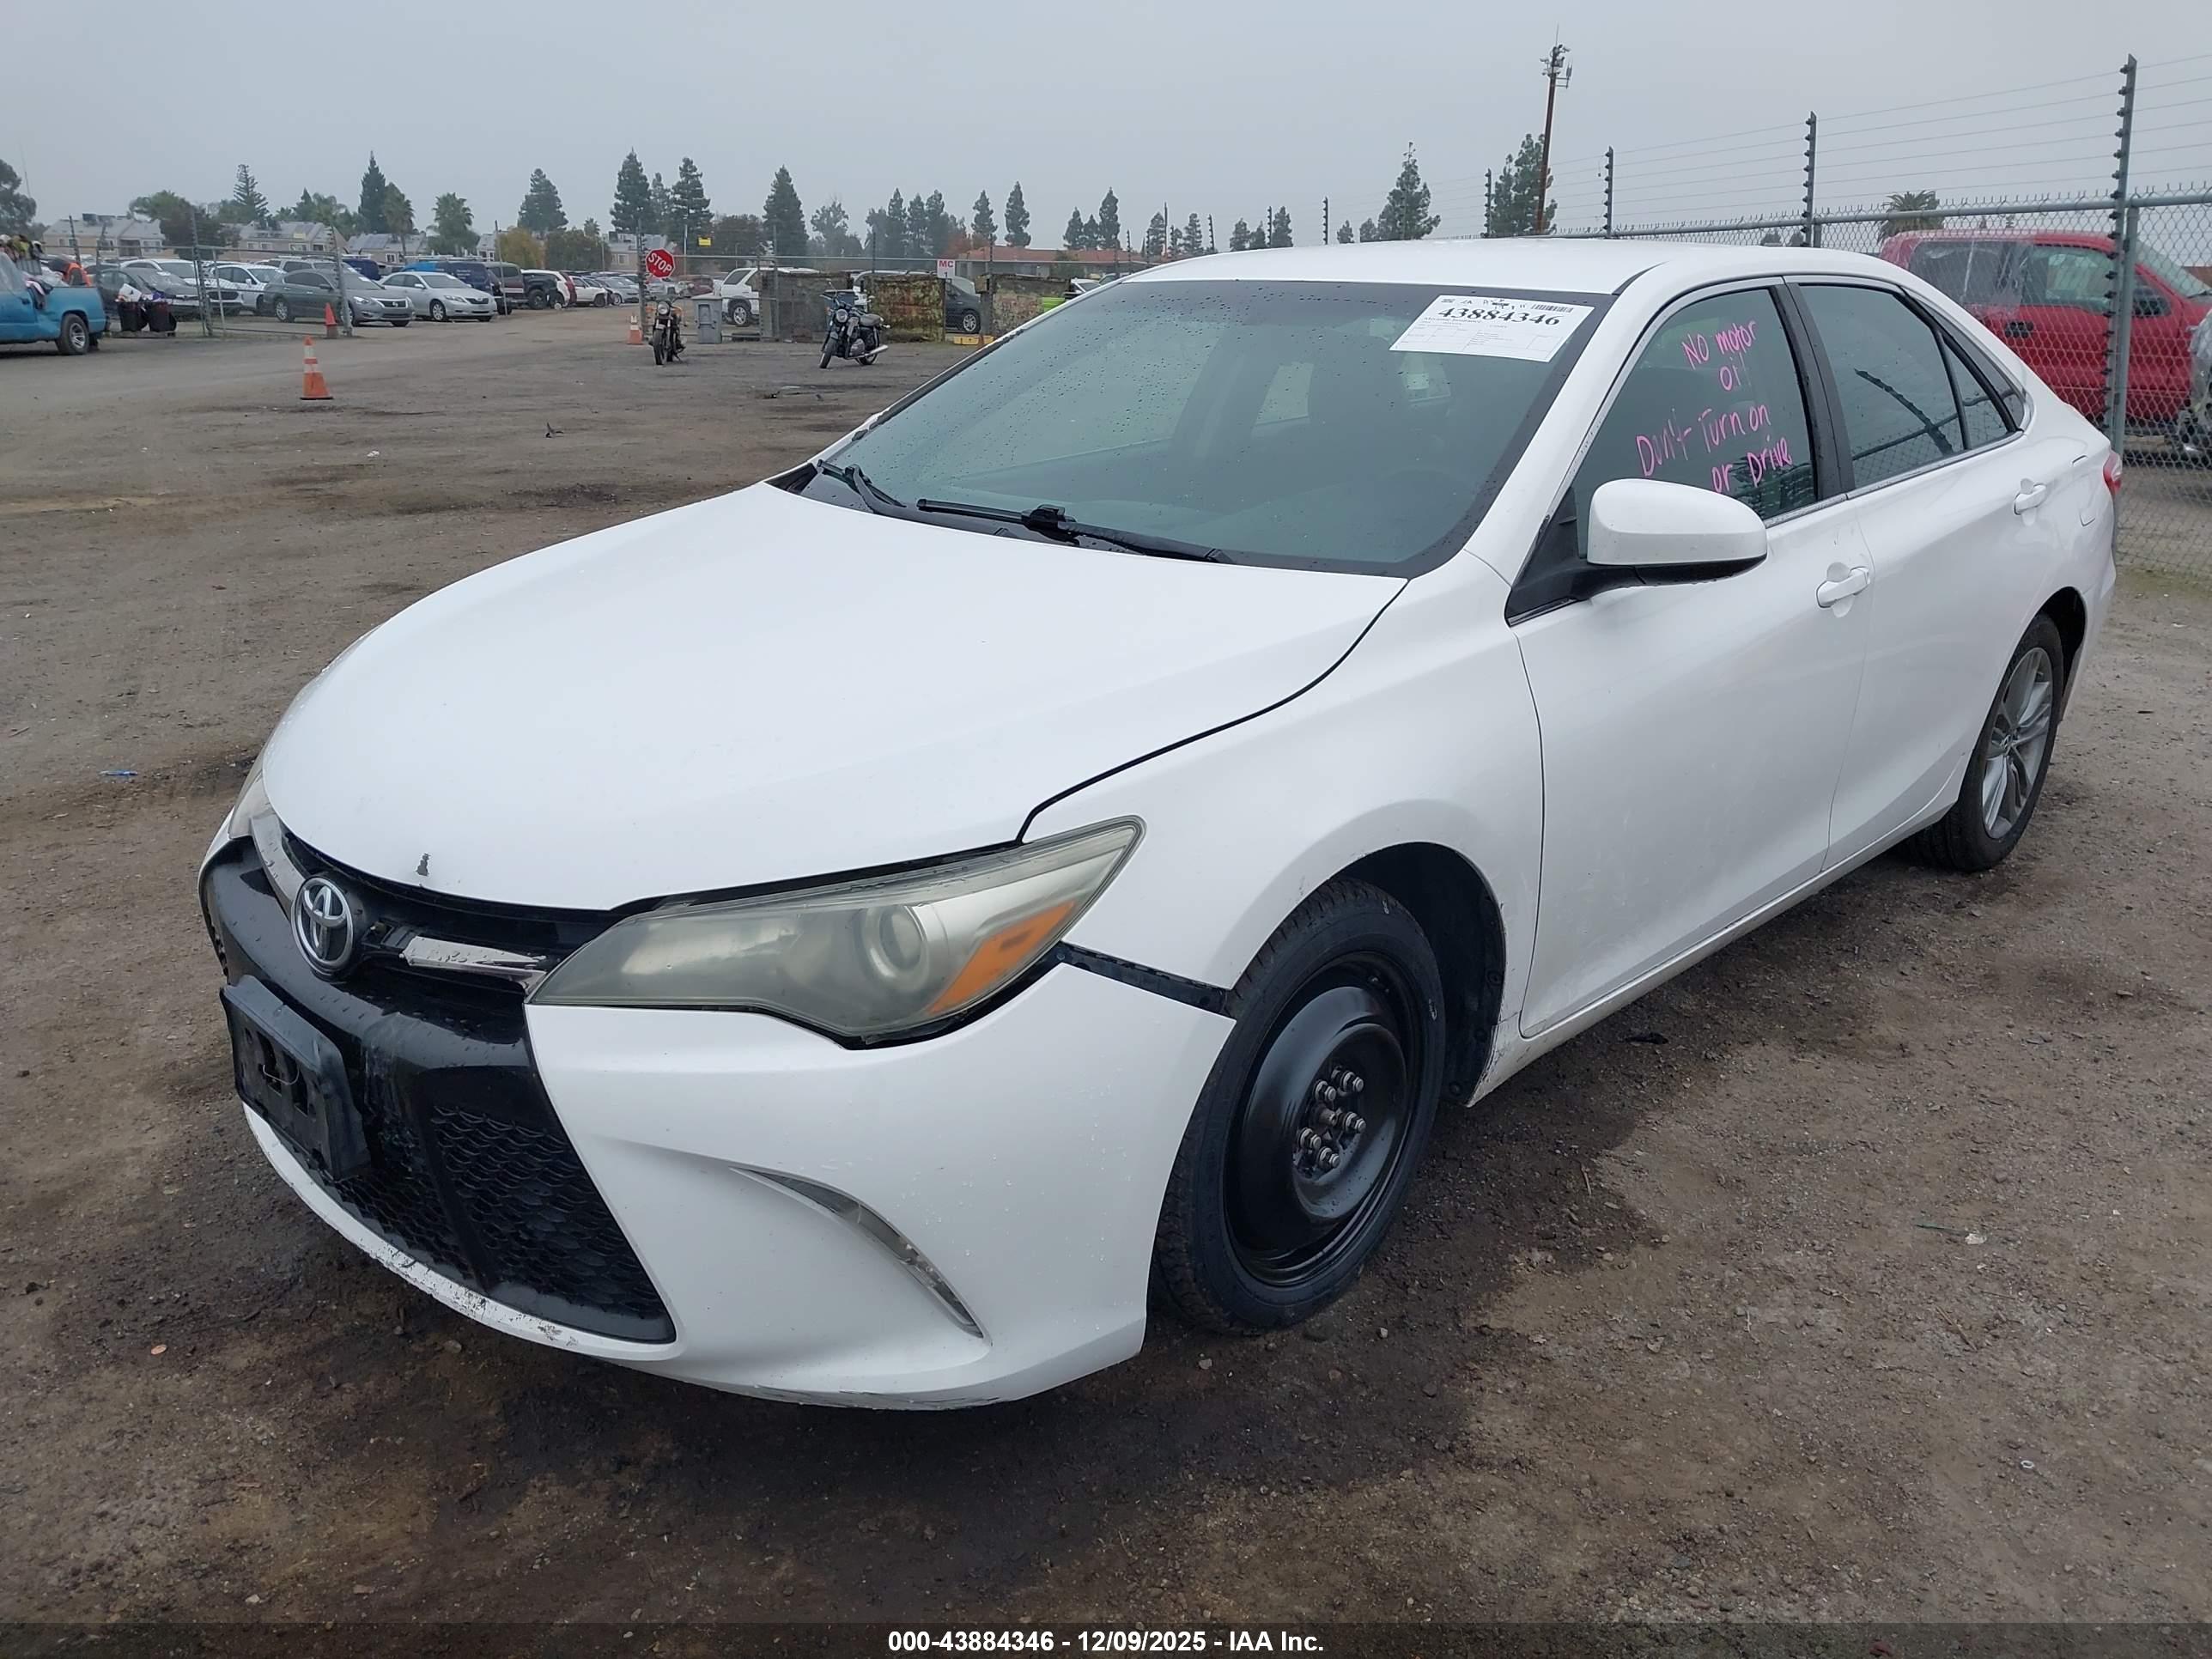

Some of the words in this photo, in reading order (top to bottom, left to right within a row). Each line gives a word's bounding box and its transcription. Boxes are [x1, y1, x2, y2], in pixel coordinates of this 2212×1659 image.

[647, 252, 672, 273] STOP
[1438, 307, 1564, 325] 43884346
[1681, 333, 1710, 370] NO
[1715, 320, 1758, 354] motor
[1698, 408, 1746, 453] Turn
[1748, 404, 1771, 432] on
[1711, 463, 1733, 494] or
[1747, 434, 1793, 488] Drive
